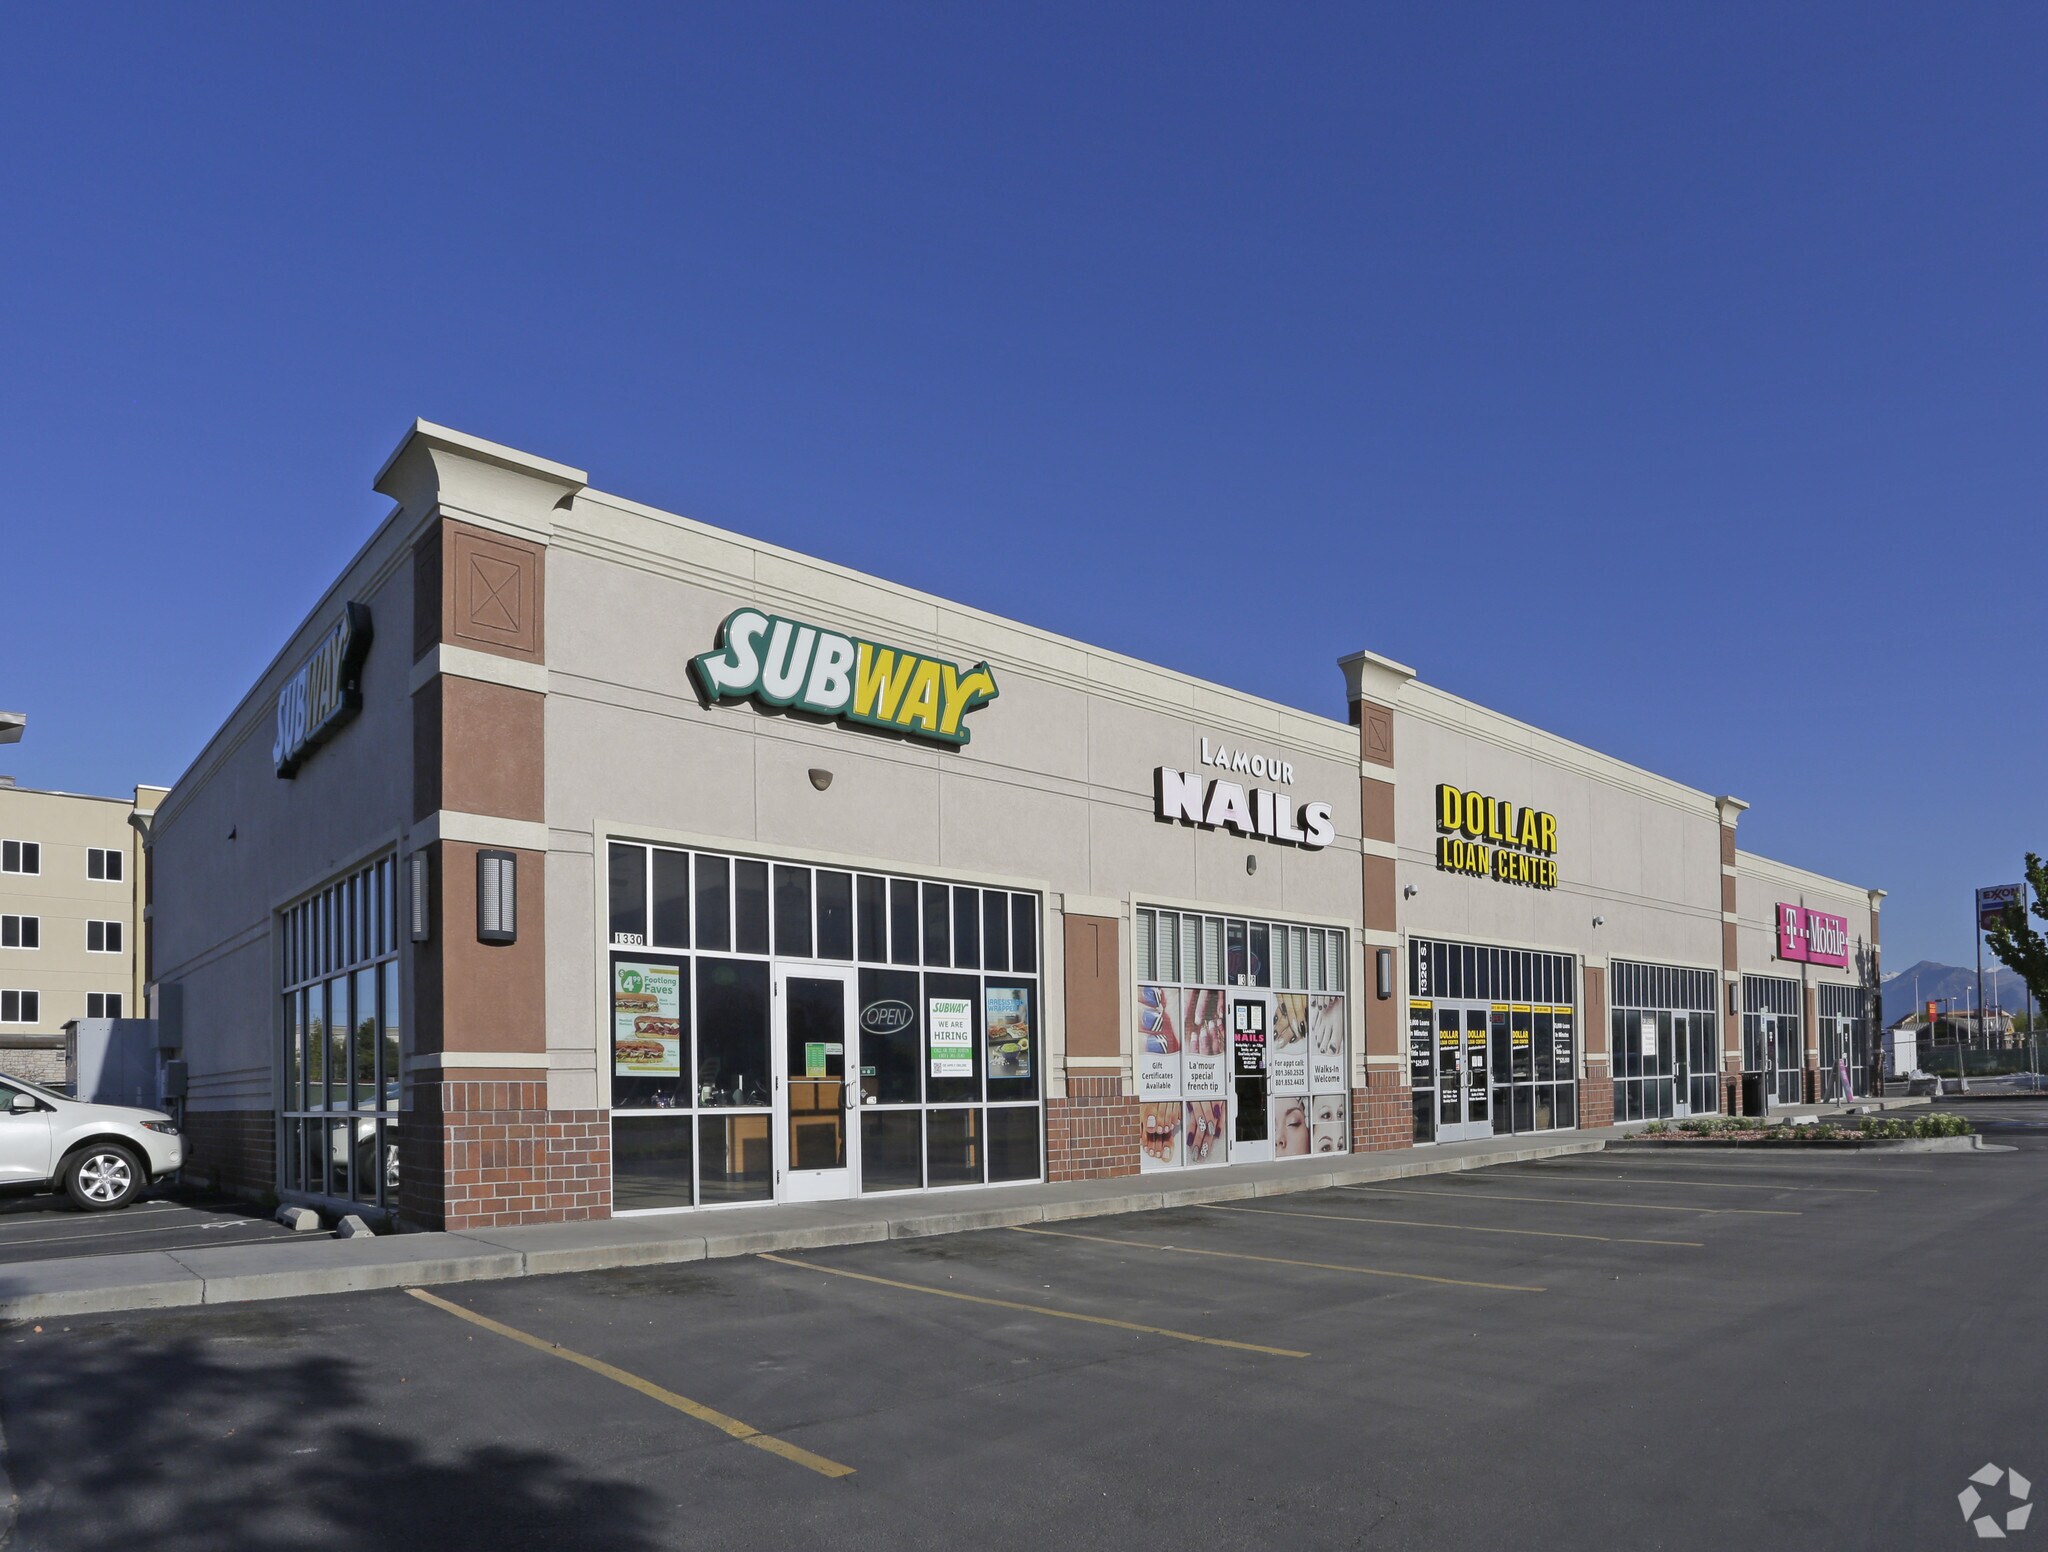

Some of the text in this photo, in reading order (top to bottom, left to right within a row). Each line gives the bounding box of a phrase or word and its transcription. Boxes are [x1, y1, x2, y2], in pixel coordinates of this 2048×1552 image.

[703, 611, 996, 736] SUBWAY
[273, 612, 351, 764] SUBWAY
[1201, 737, 1294, 784] LAMOUR
[1156, 766, 1336, 848] NAILS
[1437, 784, 1557, 854] DOLLAR
[1437, 837, 1557, 888] LOAN CENTER
[616, 933, 642, 945] 1330
[644, 976, 677, 986] Footlong
[1420, 962, 1428, 993] 1326
[644, 984, 673, 994] Faves
[933, 1002, 968, 1013] SUBWAY
[867, 1008, 907, 1025] OPEN
[934, 1031, 968, 1040] HIRING
[1234, 1033, 1264, 1042] NAILS
[1440, 1030, 1459, 1039] DOLLAR
[1467, 1030, 1486, 1039] DOLLAR
[1512, 1030, 1528, 1038] DOLLAR
[1152, 1062, 1163, 1070] Gift
[1189, 1061, 1215, 1070] La'mour
[1141, 1072, 1174, 1080] Certificates
[1191, 1072, 1213, 1082] special
[1314, 1075, 1340, 1083] Welcome
[1145, 1082, 1171, 1090] Available
[1187, 1082, 1219, 1092] french tip
